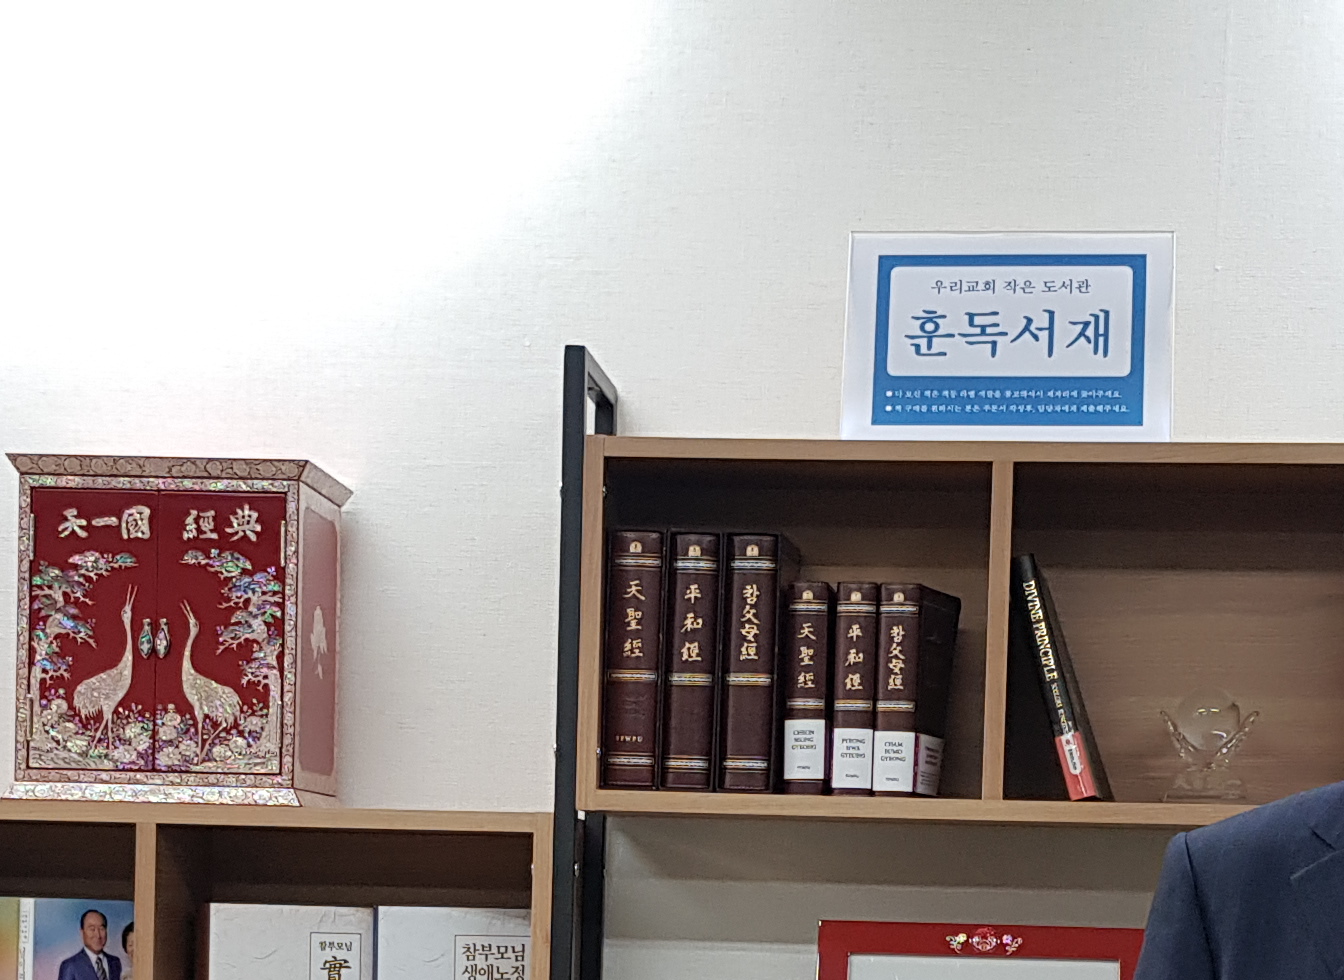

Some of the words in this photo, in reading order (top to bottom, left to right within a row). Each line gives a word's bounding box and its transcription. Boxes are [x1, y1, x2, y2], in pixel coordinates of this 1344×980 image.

[931, 279, 996, 296] 우리교회
[1003, 279, 1036, 295] 작은
[1042, 279, 1092, 295] 도서관
[904, 308, 1111, 358] 훈독서재
[58, 505, 151, 540] 天一國
[182, 504, 261, 542] 經典
[623, 580, 645, 657] 天聖經
[681, 584, 702, 662] 平和經
[1023, 580, 1043, 622] DIVINE
[1034, 620, 1058, 681] PRINCIPLE
[797, 623, 816, 688] 天聖經
[462, 943, 526, 962] 참부모님
